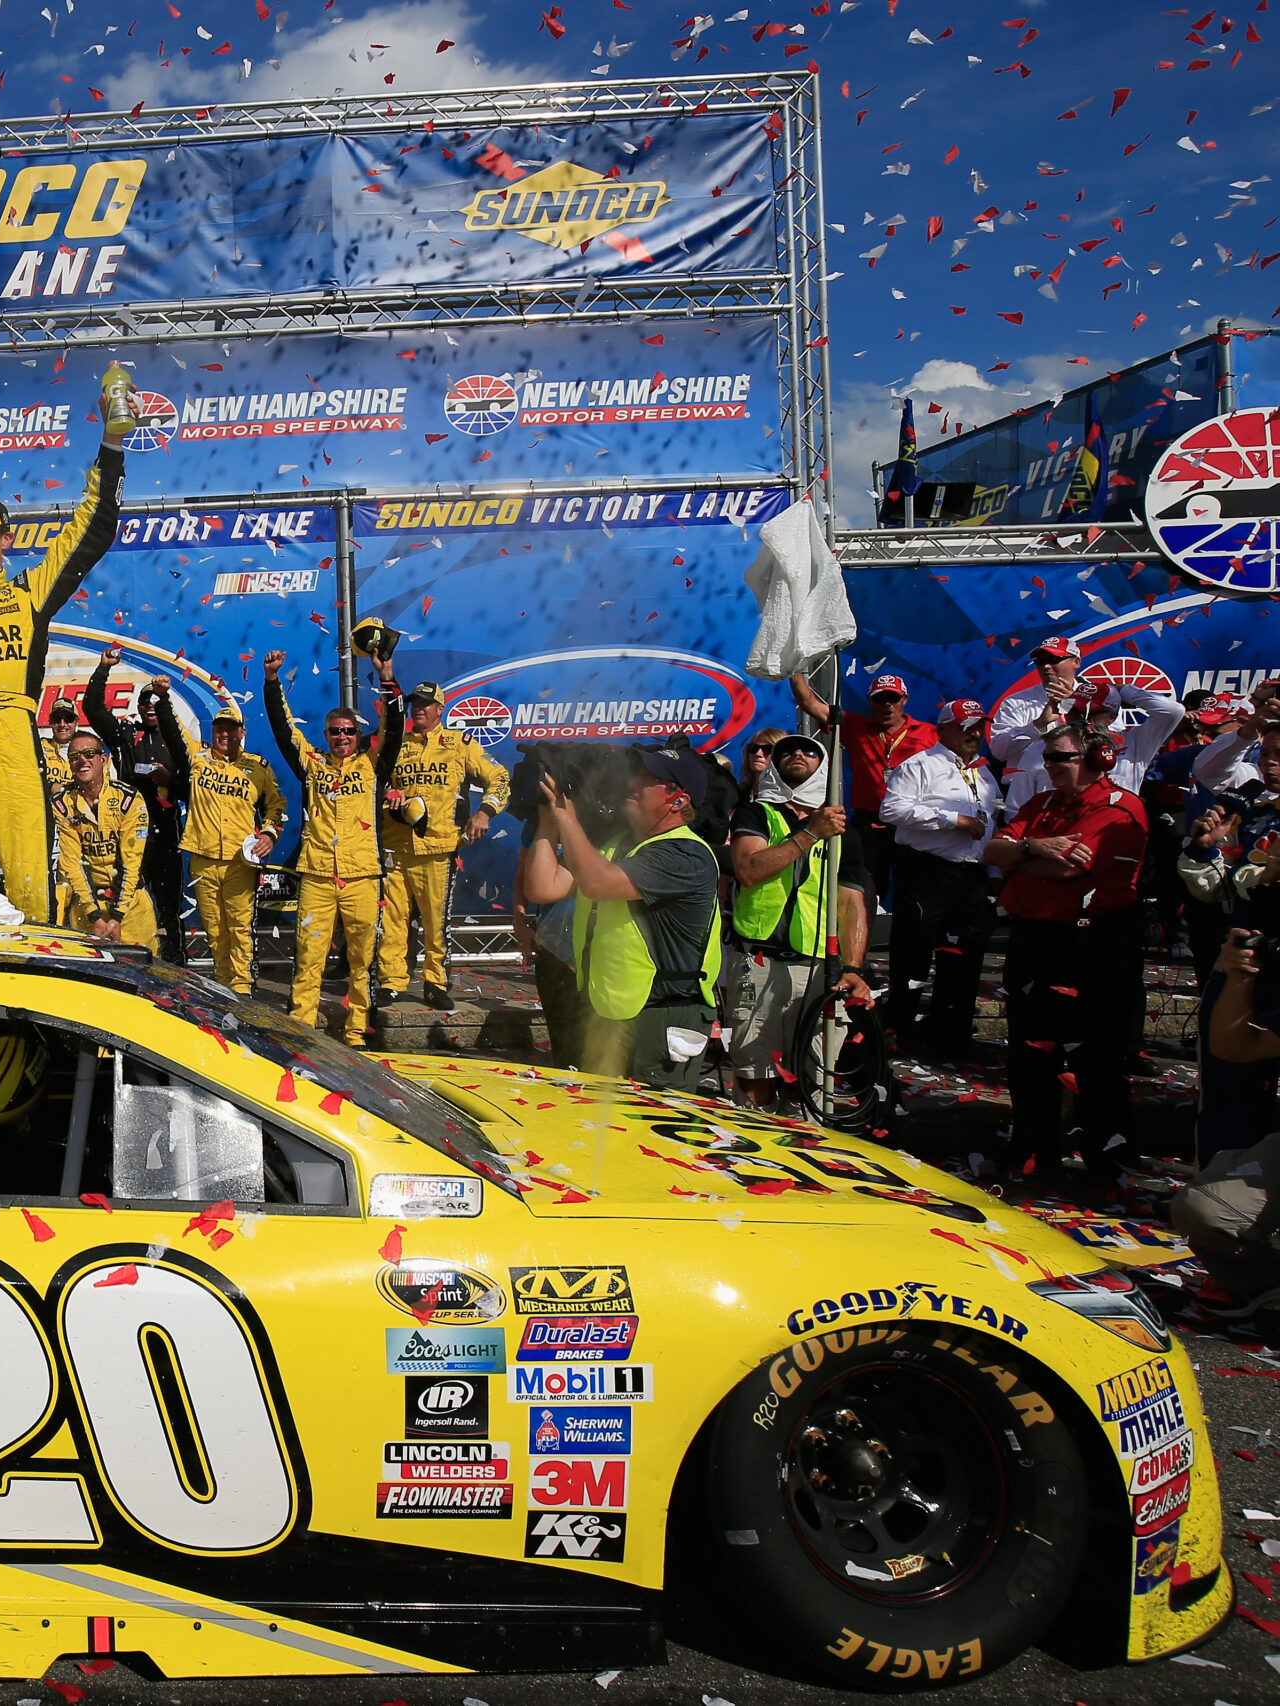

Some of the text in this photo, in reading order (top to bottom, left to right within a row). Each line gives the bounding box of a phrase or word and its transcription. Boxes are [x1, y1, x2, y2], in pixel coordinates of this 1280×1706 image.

[470, 184, 661, 227] SUNOCO
[522, 374, 751, 409] NEW HAMPSHIRE
[182, 387, 408, 423] NEW HAMPSHIRE
[522, 404, 744, 424] MOTOR SPEEDWAY
[182, 417, 399, 439] MOTOR SPEEDWAY
[375, 490, 764, 530] SUNOCO VICTORY LANE
[118, 510, 315, 545] CTORY LANE
[247, 571, 314, 592] NASCAR
[514, 698, 718, 725] NEW HAMPSHIRE
[515, 723, 708, 739] MOTOR SPEEDWAY
[202, 766, 250, 789] DOLLAR
[396, 762, 448, 776] DOLLAR
[197, 776, 250, 801] GENERAL
[412, 1181, 463, 1197] NASCAR
[412, 1272, 455, 1286] NASCAR
[420, 1287, 463, 1304] Sprint
[518, 1297, 632, 1314] MECHANIX WEAR
[528, 1321, 631, 1345] Duralast
[405, 1337, 499, 1360] Coors LIGHT
[554, 1349, 604, 1360] BRAKES
[515, 1367, 634, 1394] Mobil 1
[1100, 1357, 1172, 1414] MOOG
[428, 1386, 464, 1409] IR
[598, 1393, 644, 1401] LUBRICANTS
[414, 1417, 455, 1427] Ingersoll
[564, 1416, 623, 1430] SHERWIN
[752, 1391, 780, 1432] R20
[1120, 1393, 1186, 1453] MAHLE
[389, 1445, 486, 1462] LINCOLN
[1136, 1443, 1182, 1487] COMP
[411, 1464, 496, 1479] WELDERS
[531, 1460, 626, 1507] 3M
[382, 1486, 505, 1514] FLOWMASTER
[1136, 1487, 1190, 1526] Edelbrock
[894, 1558, 917, 1575] AERO
[826, 1627, 983, 1679] EAGLE
